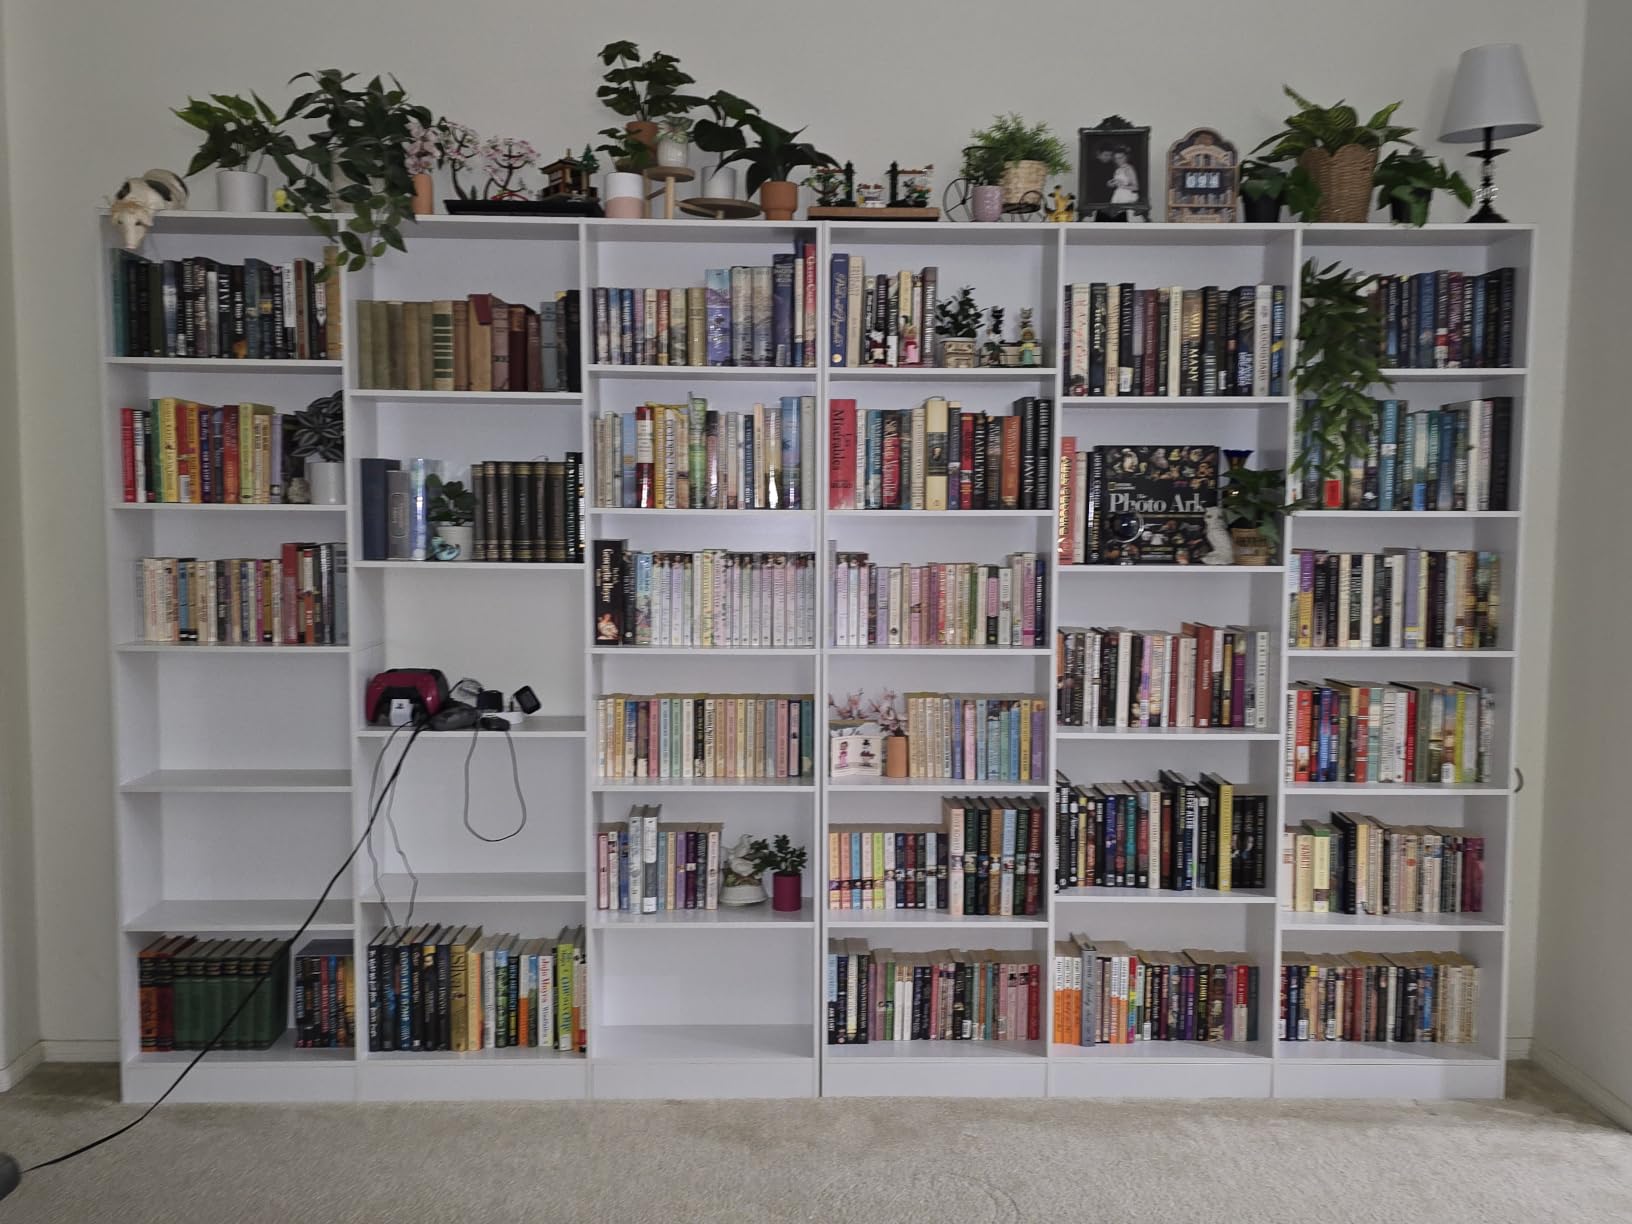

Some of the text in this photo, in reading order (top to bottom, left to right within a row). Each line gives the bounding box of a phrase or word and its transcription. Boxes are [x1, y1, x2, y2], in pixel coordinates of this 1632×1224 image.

[974, 430, 985, 490] HAMILTON
[1024, 455, 1035, 493] HAVEN
[1109, 492, 1208, 513] Photo Ark
